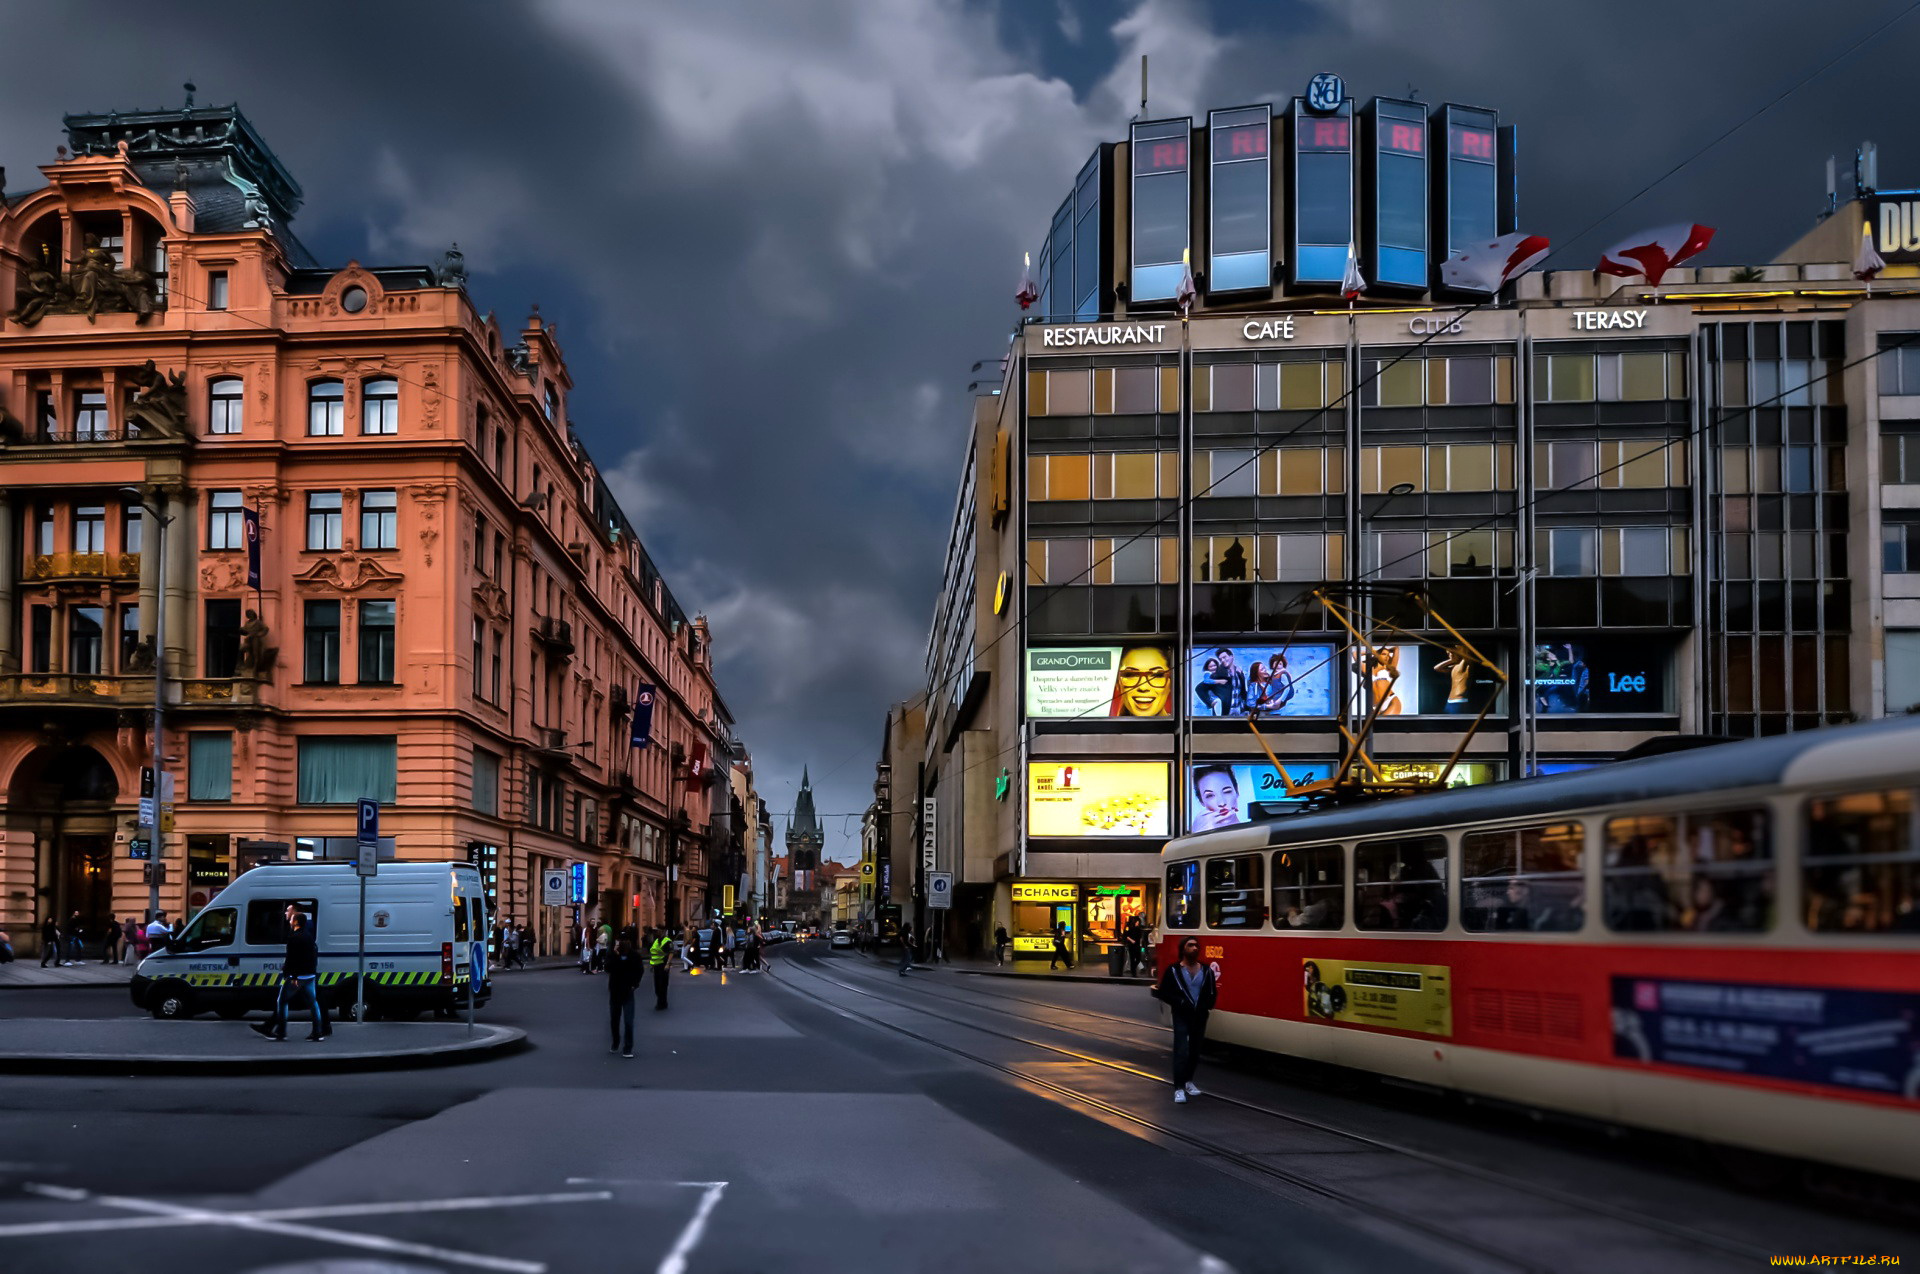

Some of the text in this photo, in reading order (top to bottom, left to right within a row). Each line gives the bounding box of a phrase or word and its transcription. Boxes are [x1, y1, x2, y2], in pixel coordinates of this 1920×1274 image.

[1243, 315, 1294, 340] CAFÉ
[1409, 316, 1463, 334] CLUB
[1573, 310, 1647, 330] TERASY
[1043, 325, 1166, 346] RESTAURANT
[1036, 655, 1105, 667] GRANDOPTICAL
[1608, 672, 1646, 693] Lee
[362, 804, 375, 830] P
[925, 802, 935, 886] DEBENHA
[1024, 888, 1078, 897] CHANGE
